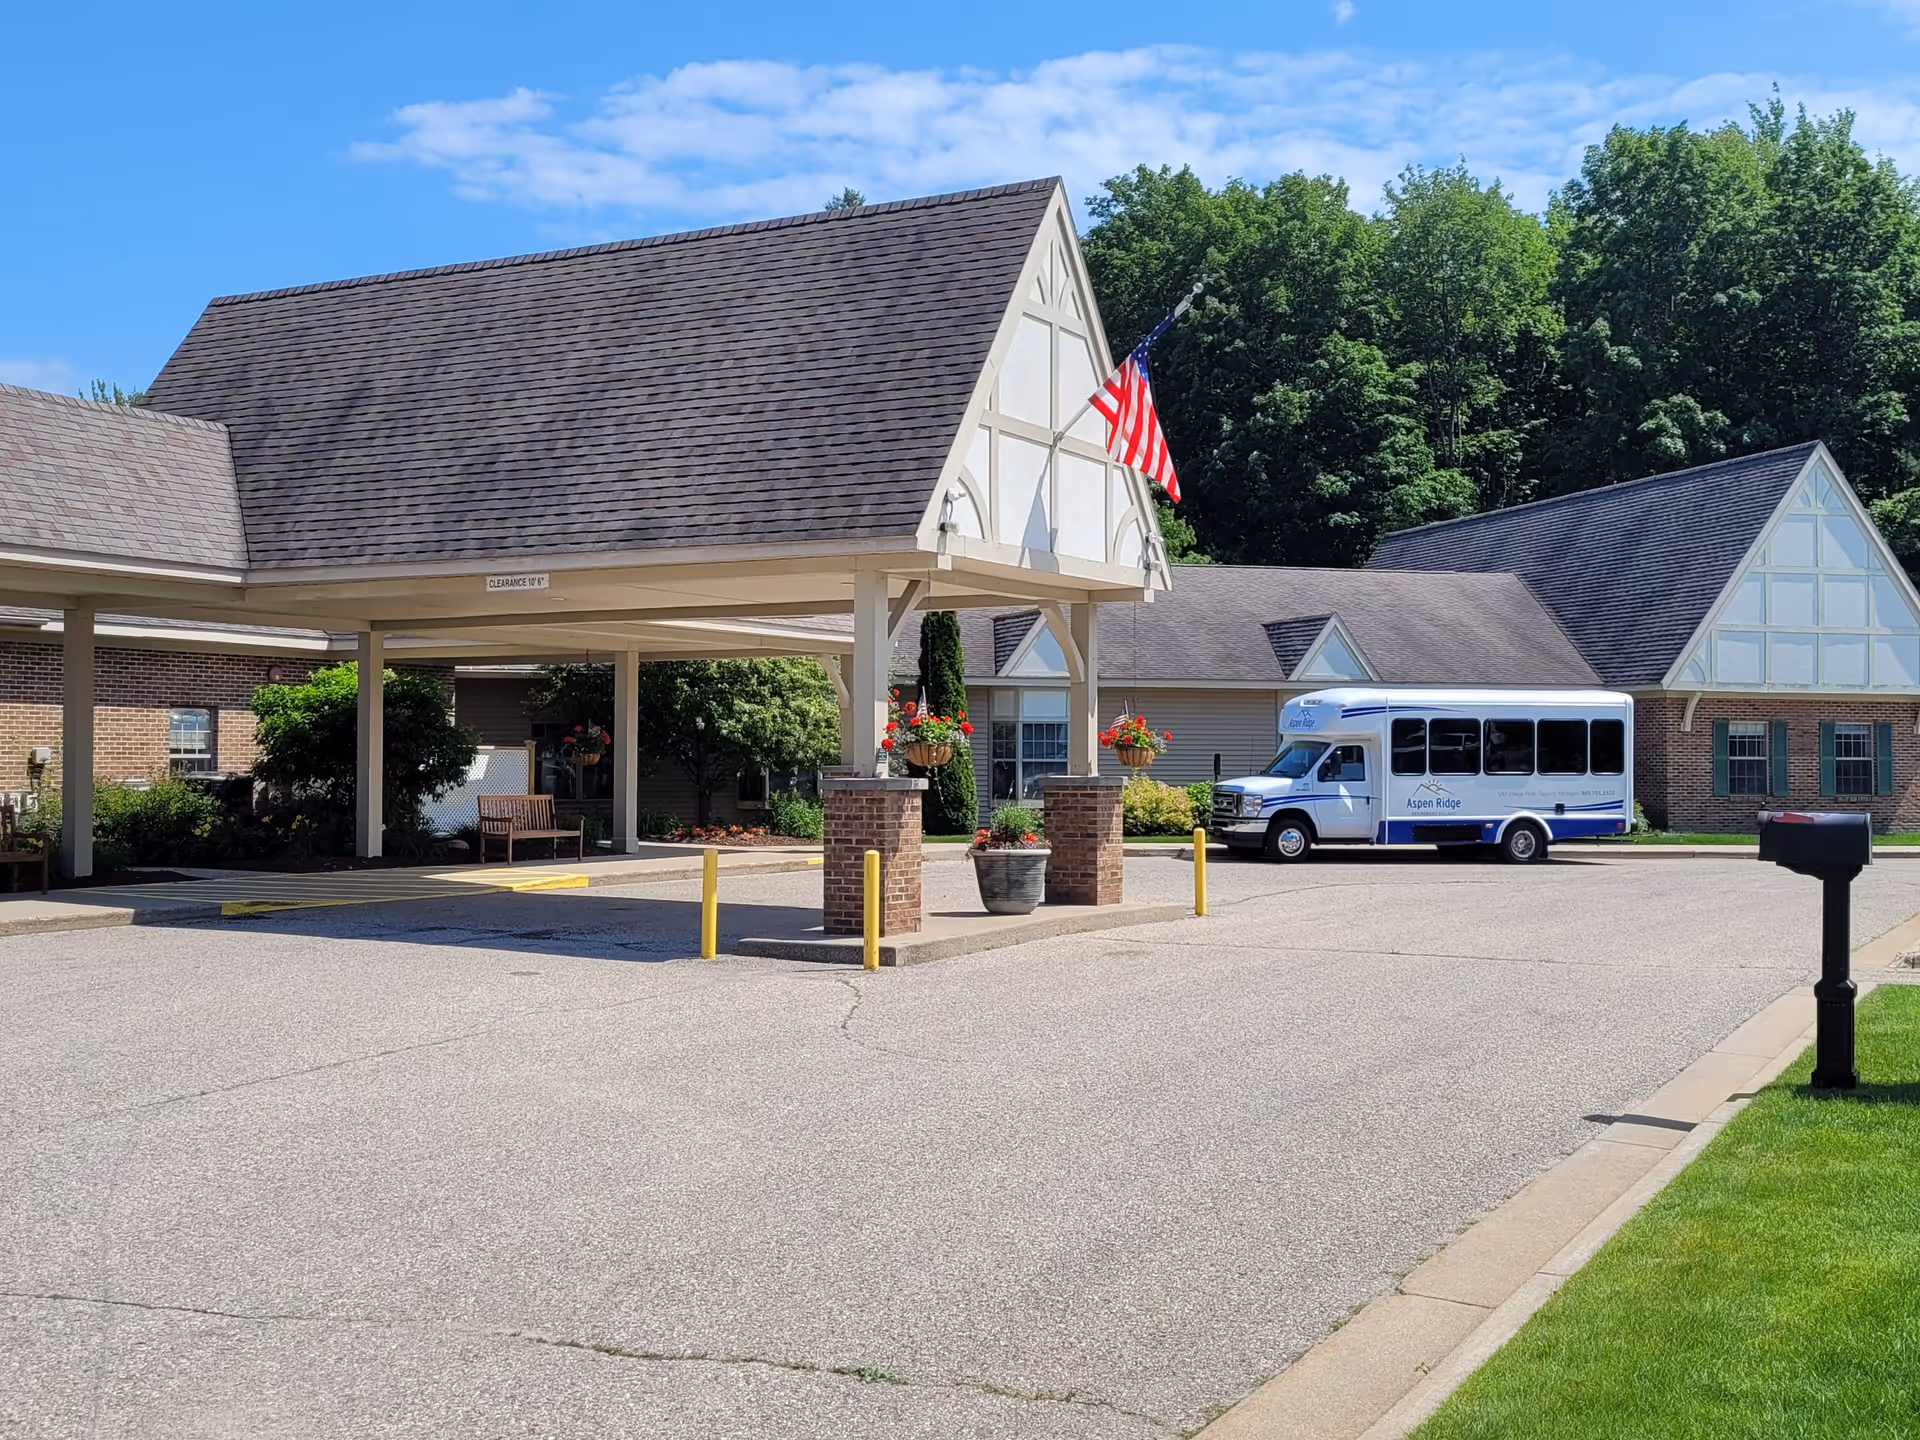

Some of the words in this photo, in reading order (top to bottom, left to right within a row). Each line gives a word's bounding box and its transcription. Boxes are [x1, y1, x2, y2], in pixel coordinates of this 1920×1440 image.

[489, 577, 527, 588] CLEARANCE
[1406, 797, 1434, 811] Aspen
[1436, 797, 1462, 811] Ridge
